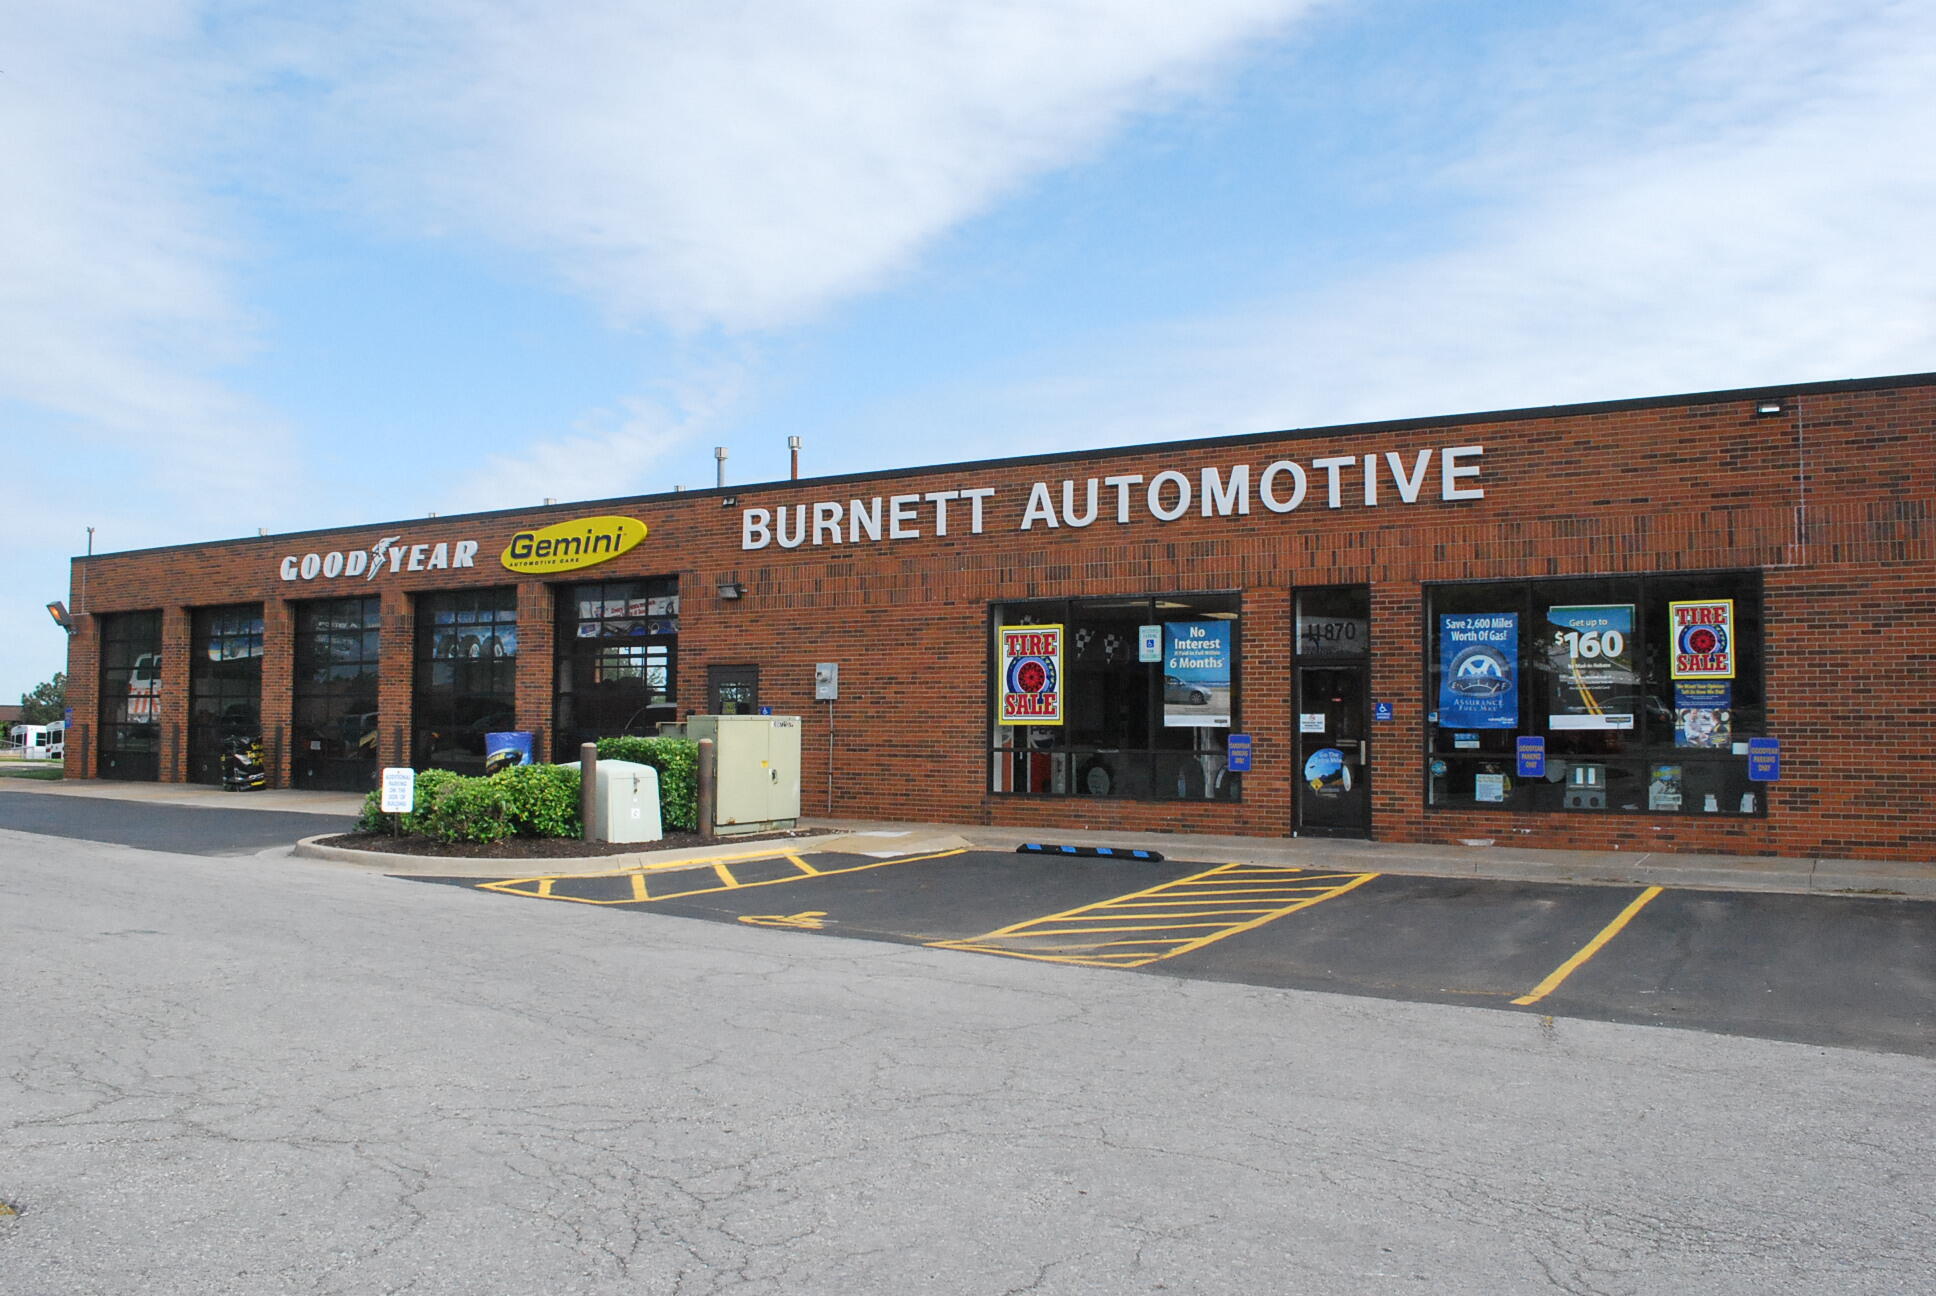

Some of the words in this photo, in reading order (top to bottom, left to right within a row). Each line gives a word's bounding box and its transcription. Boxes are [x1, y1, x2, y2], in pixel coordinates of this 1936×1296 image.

[742, 488, 995, 550] BURNETT
[1020, 446, 1484, 530] AUTOMOTIVE
[510, 526, 623, 559] Gemini
[1446, 618, 1465, 629] Save
[1466, 618, 1490, 630] 2,600
[1491, 617, 1513, 628] Miles
[1569, 619, 1584, 627] Get
[1586, 620, 1597, 628] up
[1676, 607, 1727, 625] TIRE
[1190, 626, 1206, 638] No
[1451, 630, 1477, 641] Worth
[1478, 630, 1489, 641] Of
[1489, 630, 1507, 641] Gas!
[1005, 632, 1057, 656] TIRE
[1174, 638, 1221, 649] Interest
[1170, 658, 1178, 668] 6
[1677, 653, 1728, 672] SALE
[1005, 692, 1057, 716] SALE
